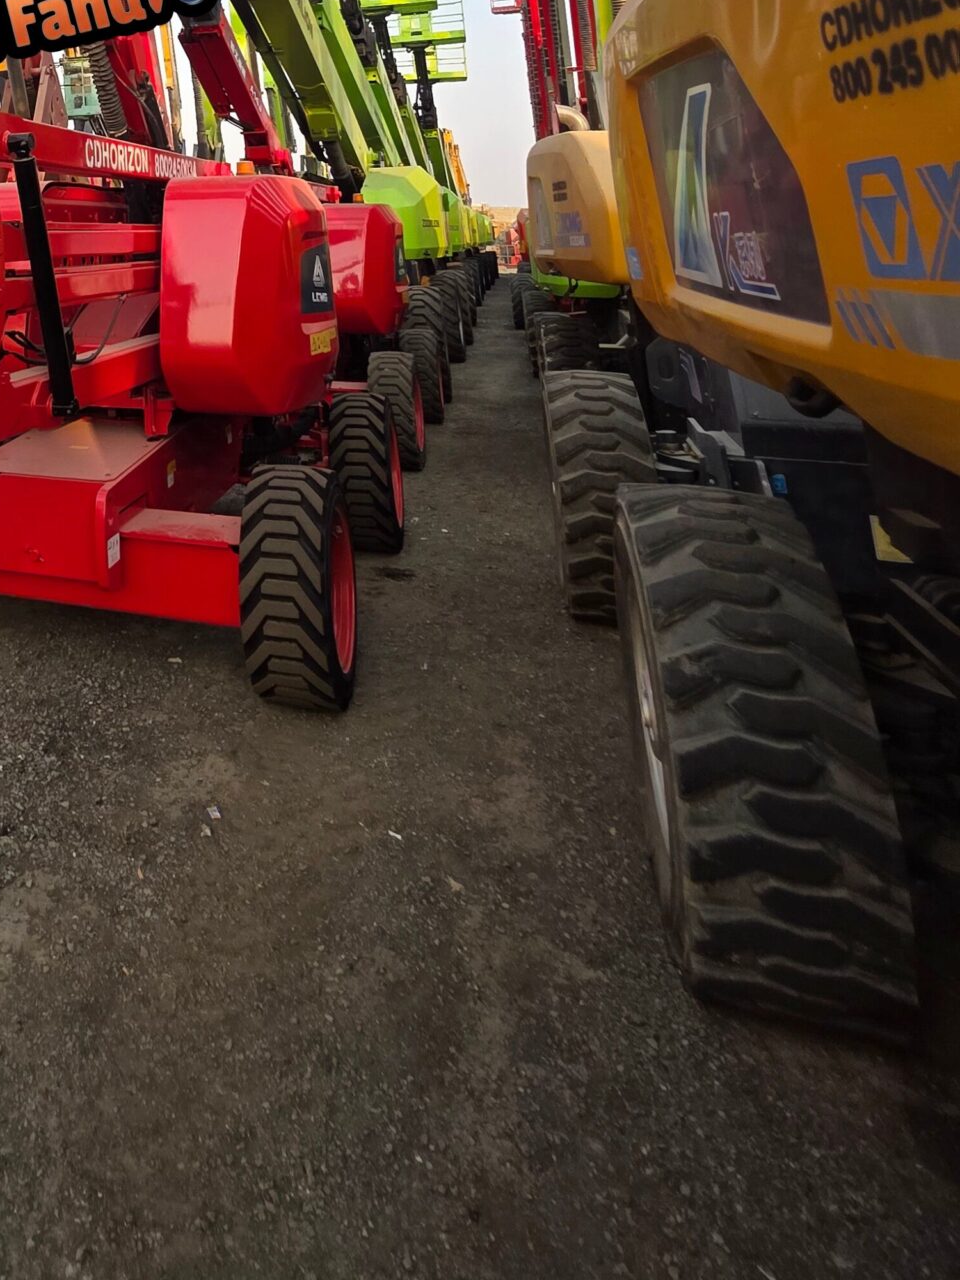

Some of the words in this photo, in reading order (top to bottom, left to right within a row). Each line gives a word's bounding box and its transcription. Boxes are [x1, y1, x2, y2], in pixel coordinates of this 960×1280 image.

[830, 56, 872, 103] 800
[871, 37, 924, 95] 245
[85, 139, 149, 173] CDHORIZON
